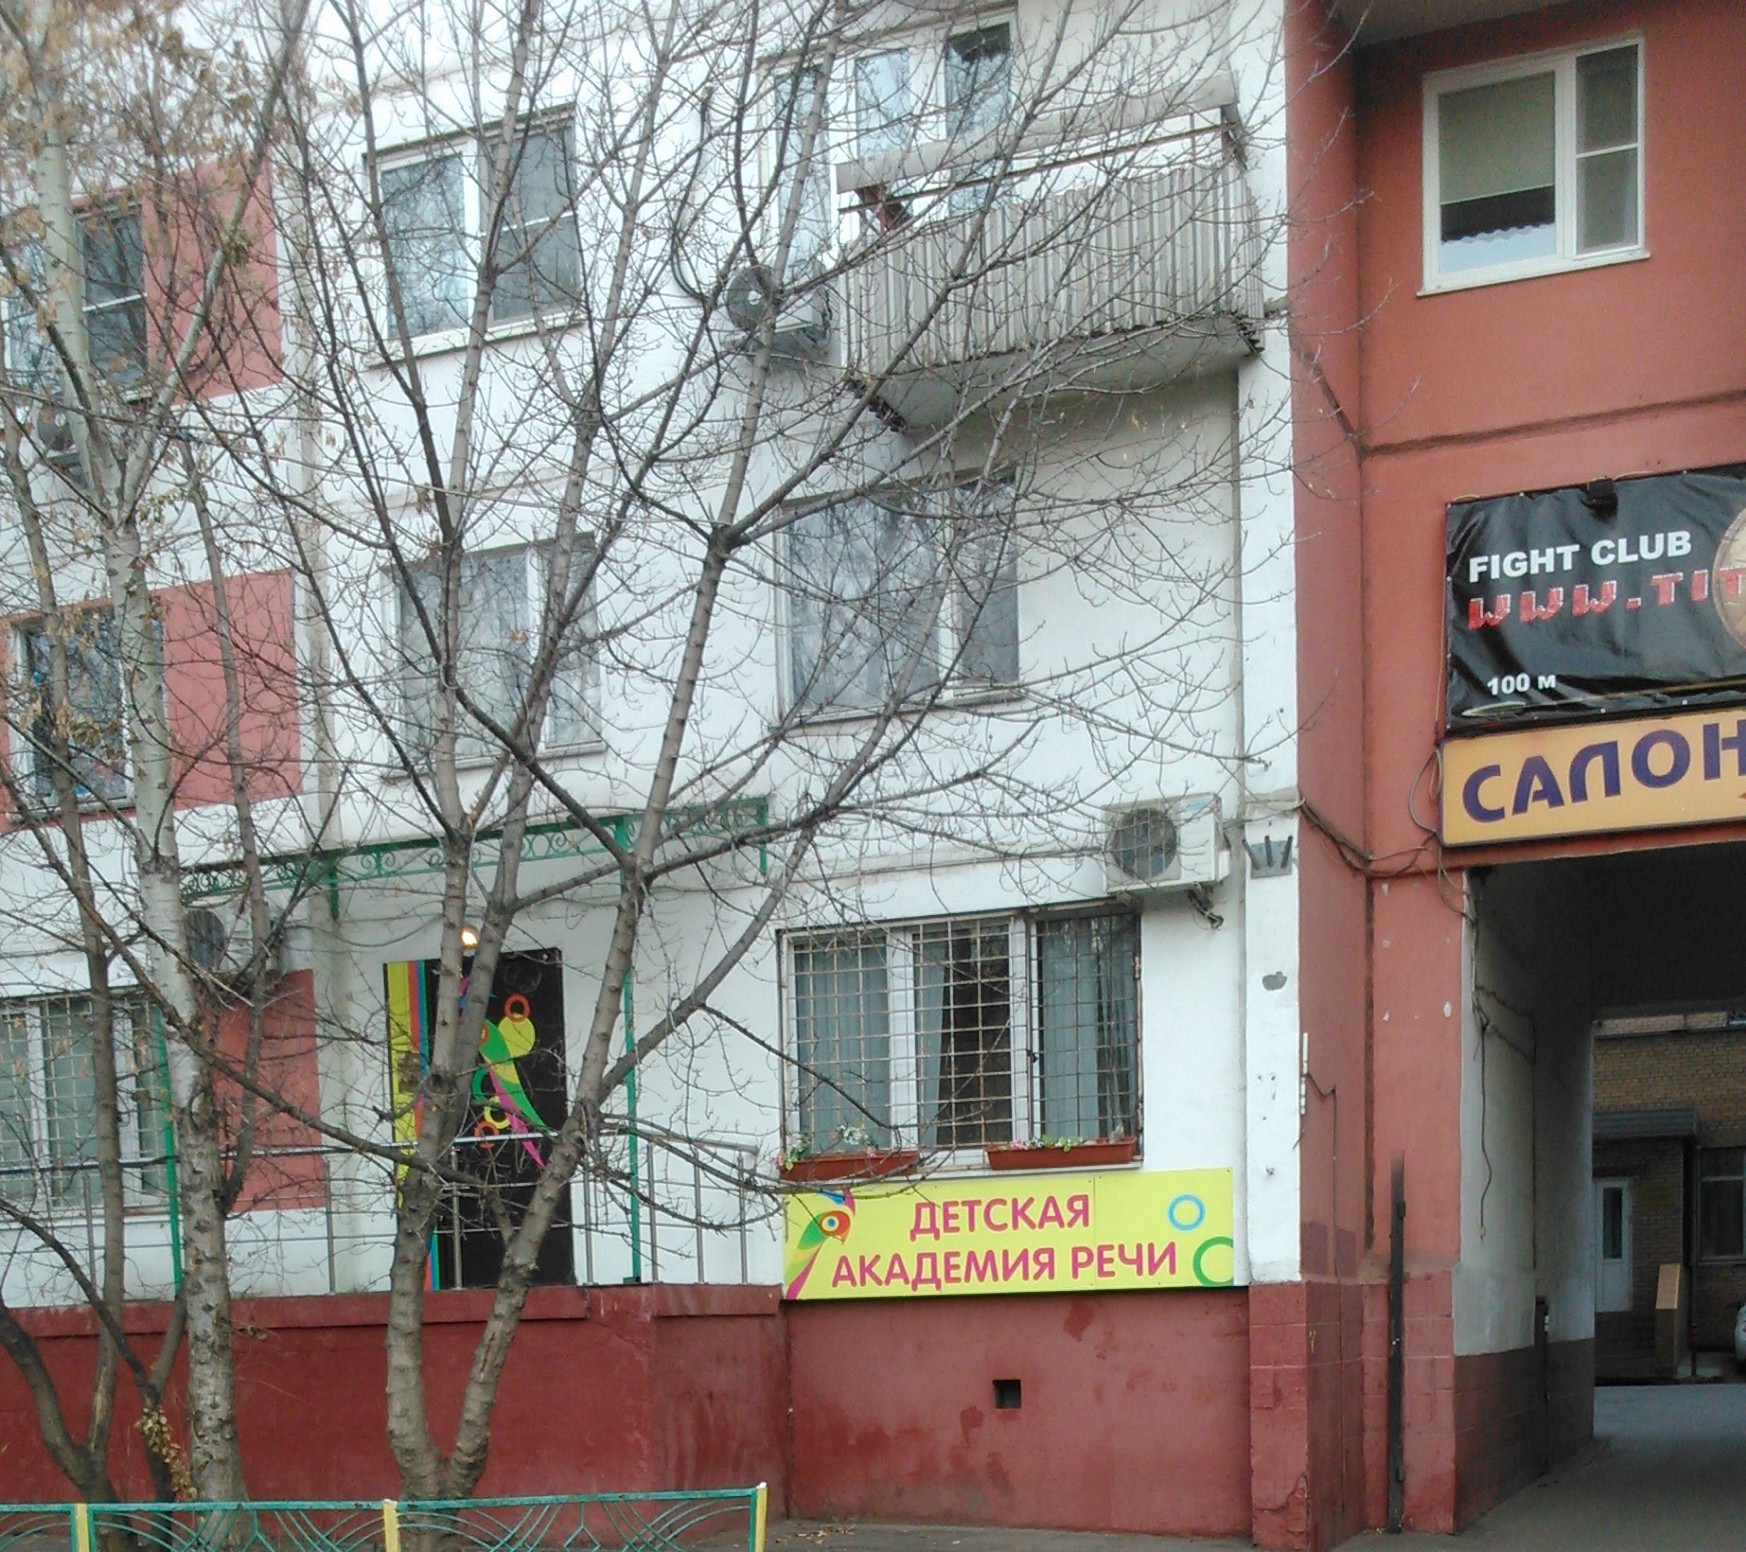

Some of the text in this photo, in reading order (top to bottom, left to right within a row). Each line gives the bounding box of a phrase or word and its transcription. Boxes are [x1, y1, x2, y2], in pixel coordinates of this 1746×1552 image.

[1468, 530, 1693, 583] FIGHT CLUB
[1486, 673, 1531, 696] 100
[1461, 718, 1746, 824] САЛОН
[909, 1194, 1091, 1242] ДЕТСКАЯ
[831, 1241, 1177, 1292] АКАДЕМИЯ РЕЧИ
